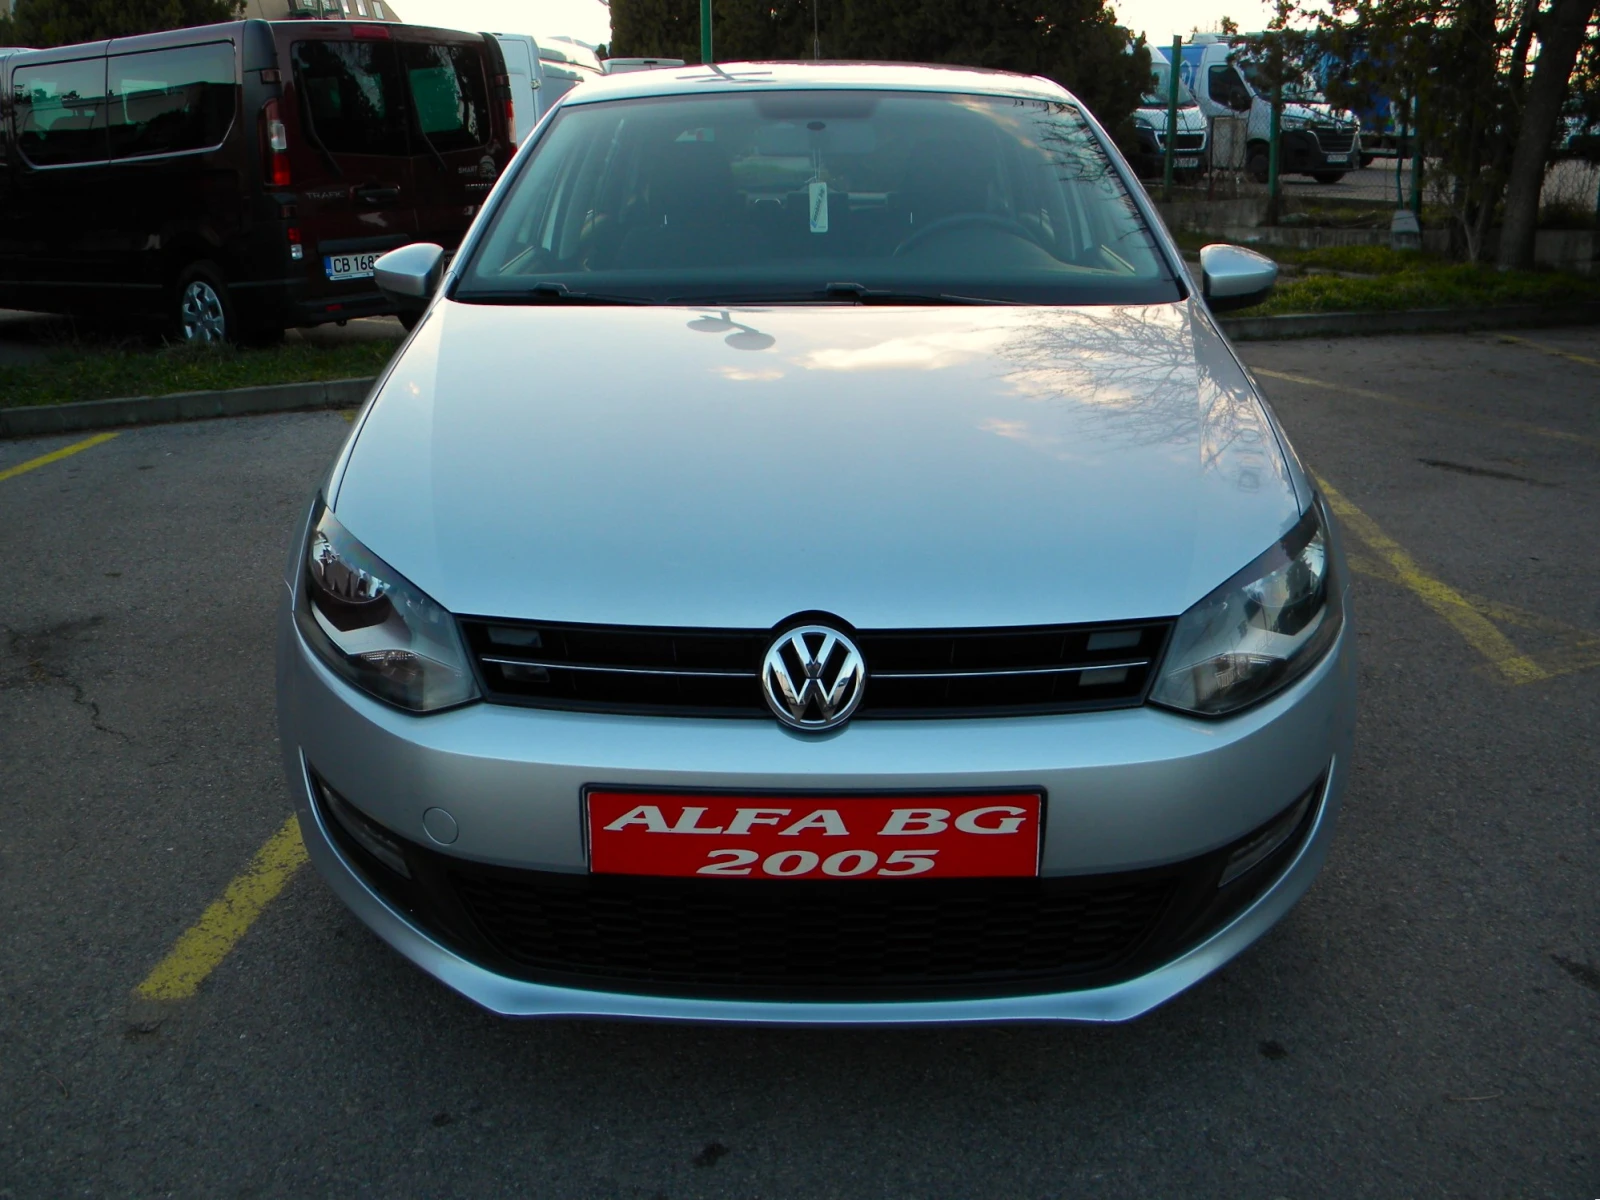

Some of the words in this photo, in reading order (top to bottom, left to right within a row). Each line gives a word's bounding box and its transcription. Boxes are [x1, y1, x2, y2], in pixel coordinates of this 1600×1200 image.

[333, 257, 351, 273] CB
[353, 254, 380, 271] 168
[603, 805, 850, 836] ALFA
[876, 805, 1027, 836] BG
[695, 849, 940, 877] 2005
